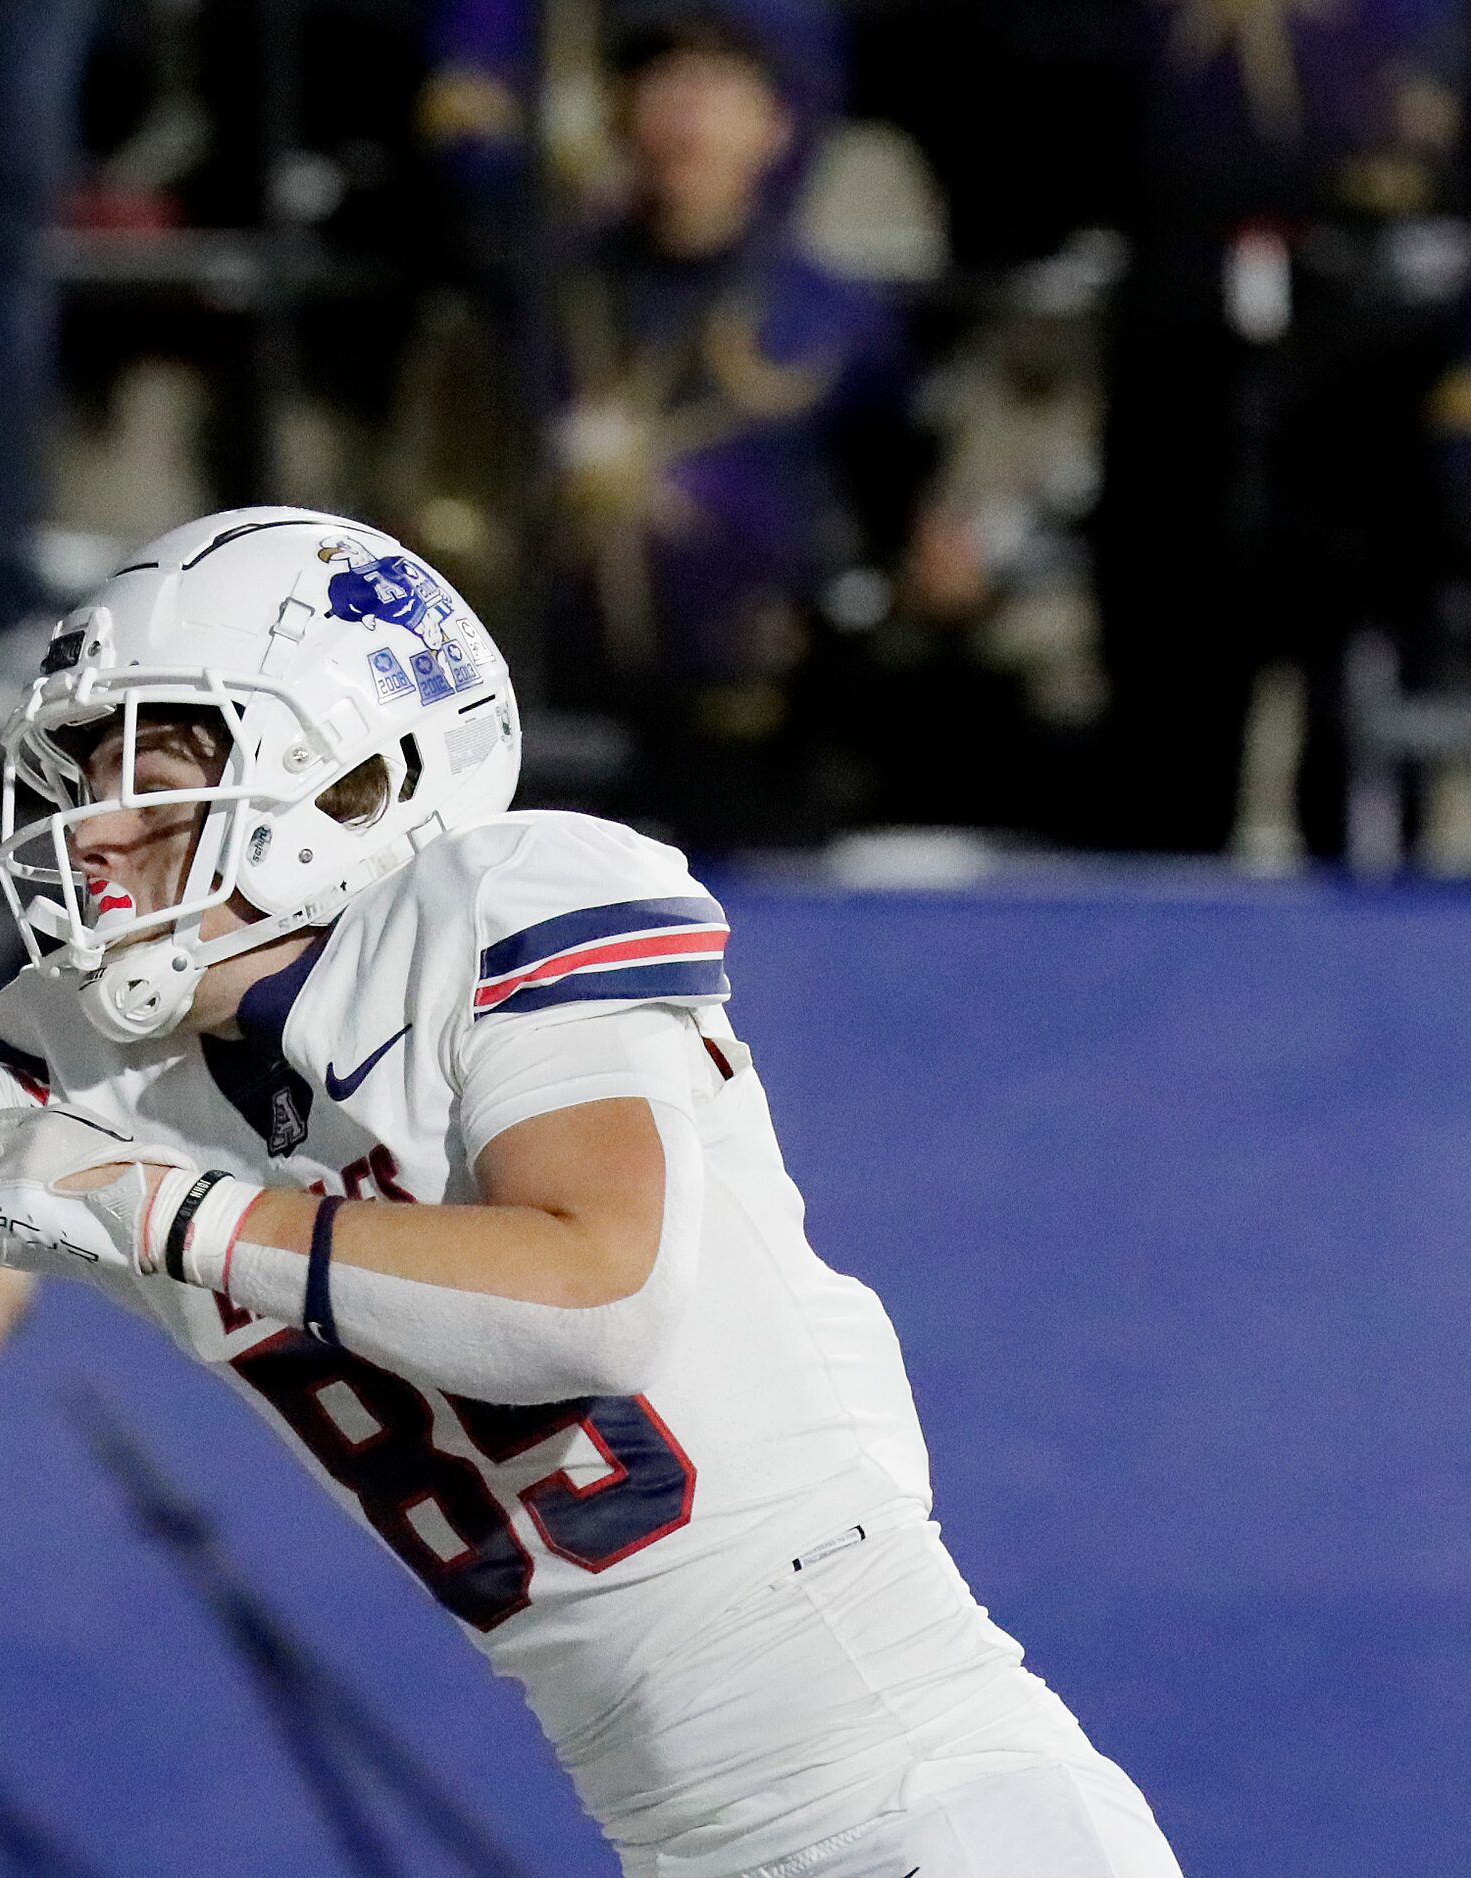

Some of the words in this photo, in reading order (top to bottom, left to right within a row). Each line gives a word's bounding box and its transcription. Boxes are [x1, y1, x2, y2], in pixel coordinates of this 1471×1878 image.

[364, 571, 407, 604] A
[420, 674, 448, 697] 2012
[453, 663, 477, 683] 2013
[269, 1087, 308, 1153] A
[189, 1179, 212, 1199] JOHN
[229, 1327, 697, 1632] 85
